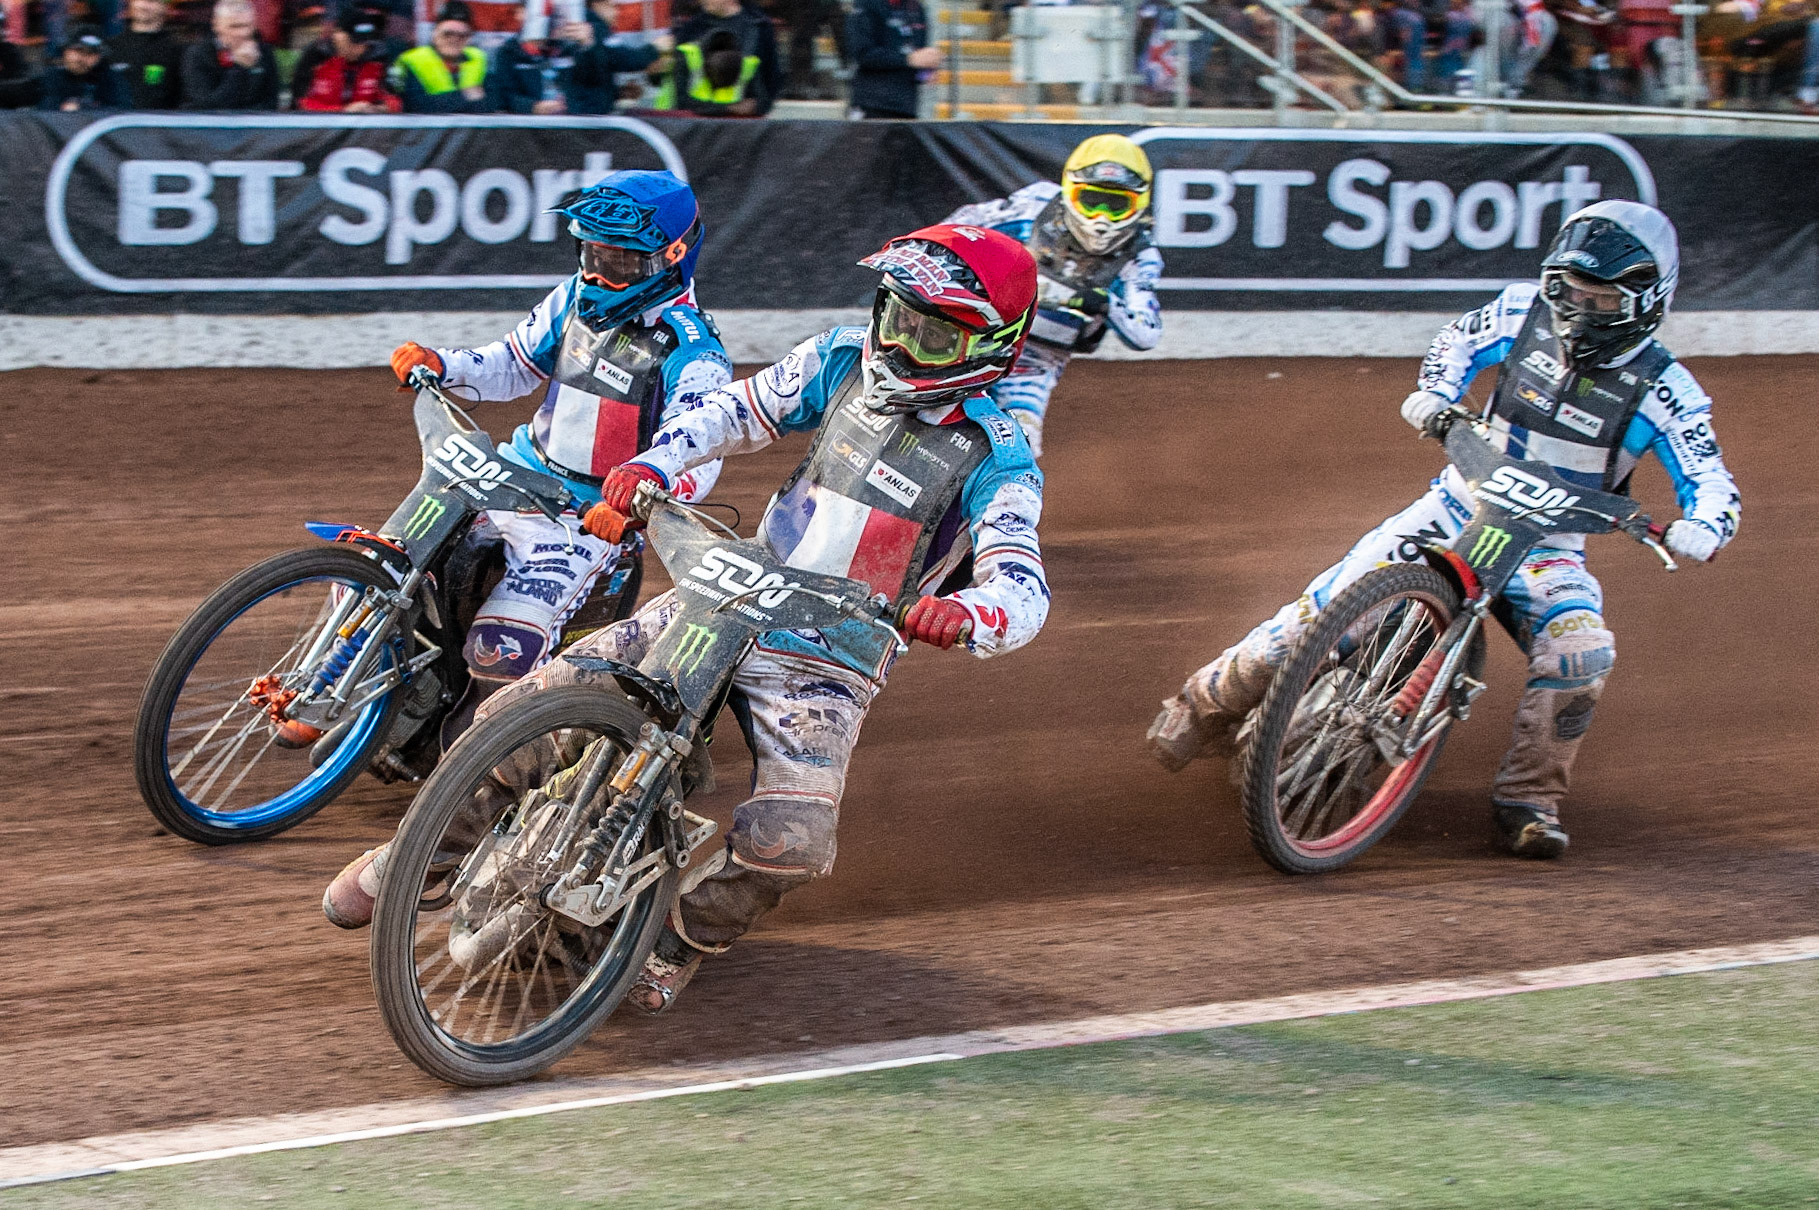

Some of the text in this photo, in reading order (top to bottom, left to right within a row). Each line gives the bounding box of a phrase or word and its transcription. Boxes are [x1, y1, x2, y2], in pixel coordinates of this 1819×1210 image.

[118, 159, 304, 245] BT
[1154, 158, 1601, 269] BT Sport
[653, 330, 669, 345] FRA
[607, 368, 630, 385] ANLAS
[950, 432, 973, 453] FRA
[433, 433, 513, 491] SDN
[548, 460, 569, 477] FRANCE
[848, 451, 868, 468] GLS
[884, 474, 916, 498] ANLAS
[1480, 465, 1581, 517] SDN
[532, 543, 592, 563] MOUL
[688, 546, 802, 610] SDN
[689, 582, 726, 604] SPEEDWAY
